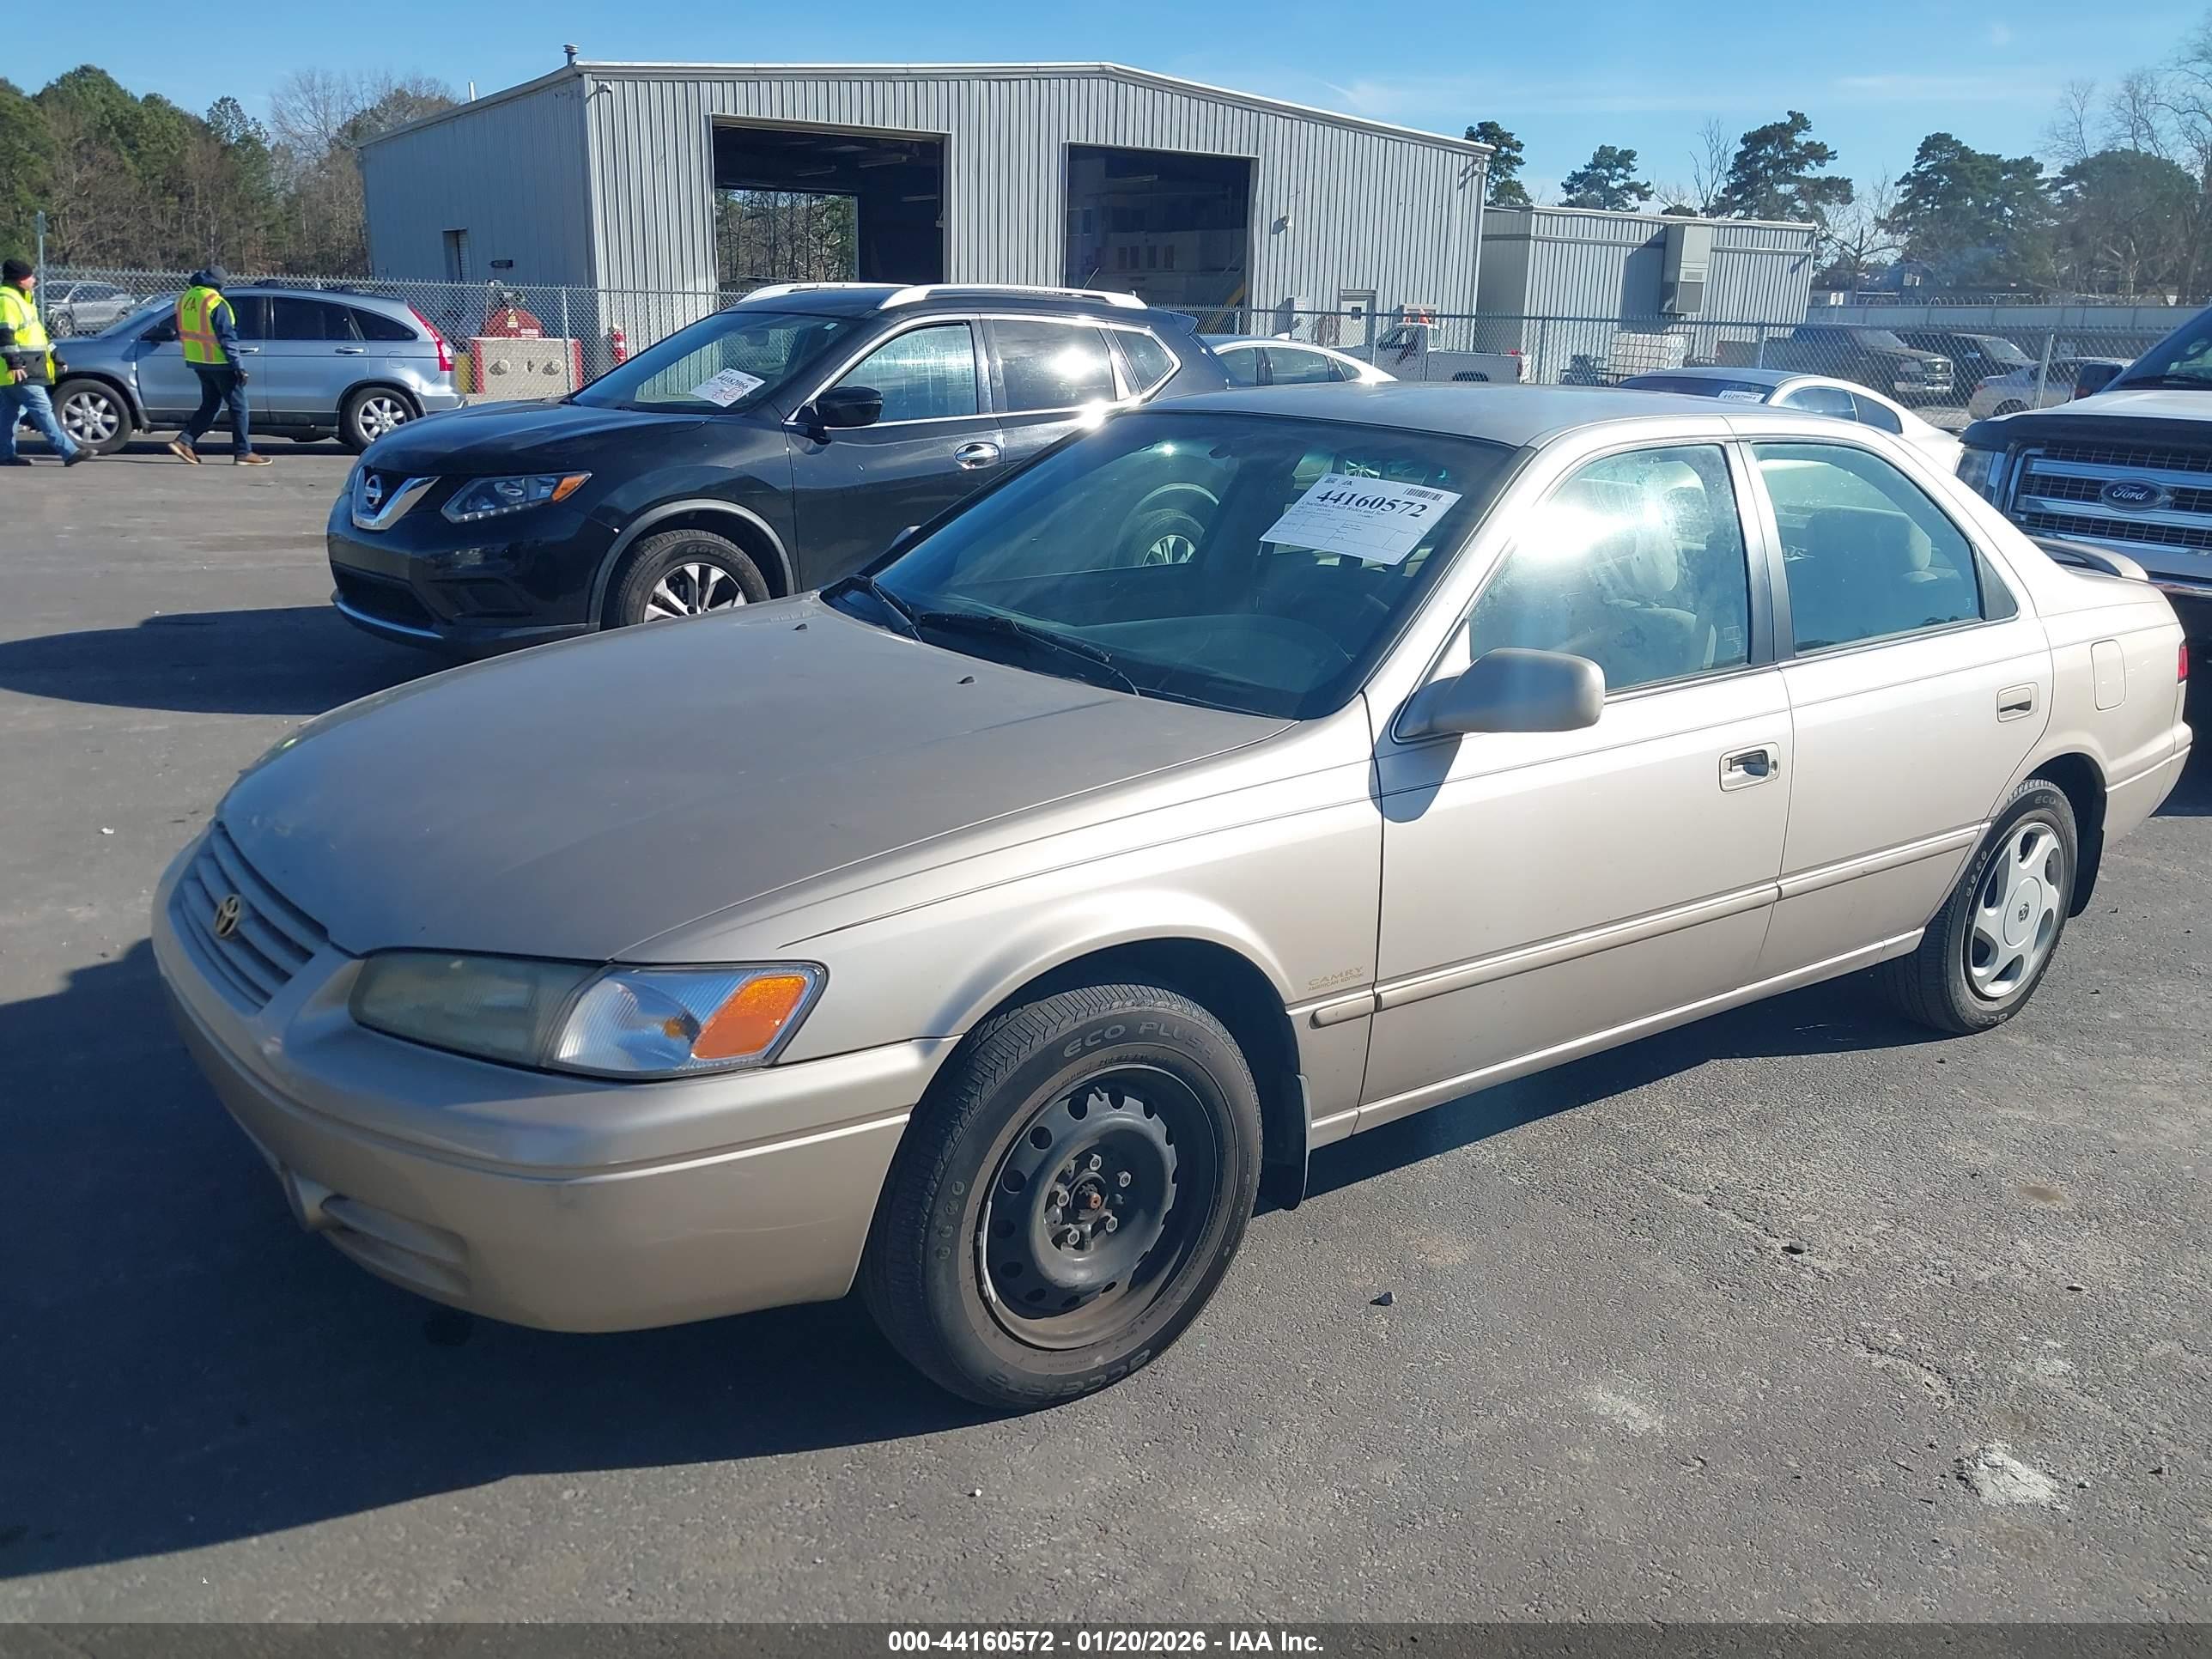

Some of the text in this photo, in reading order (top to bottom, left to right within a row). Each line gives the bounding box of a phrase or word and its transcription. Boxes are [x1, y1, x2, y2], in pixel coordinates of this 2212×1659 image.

[2112, 484, 2148, 501] Ford
[1316, 489, 1428, 518] 44160572
[2033, 795, 2057, 805] ECO
[1309, 966, 1364, 986] CAMRY
[1308, 980, 1339, 991] AMERICAN
[1063, 1024, 1127, 1058] ECO
